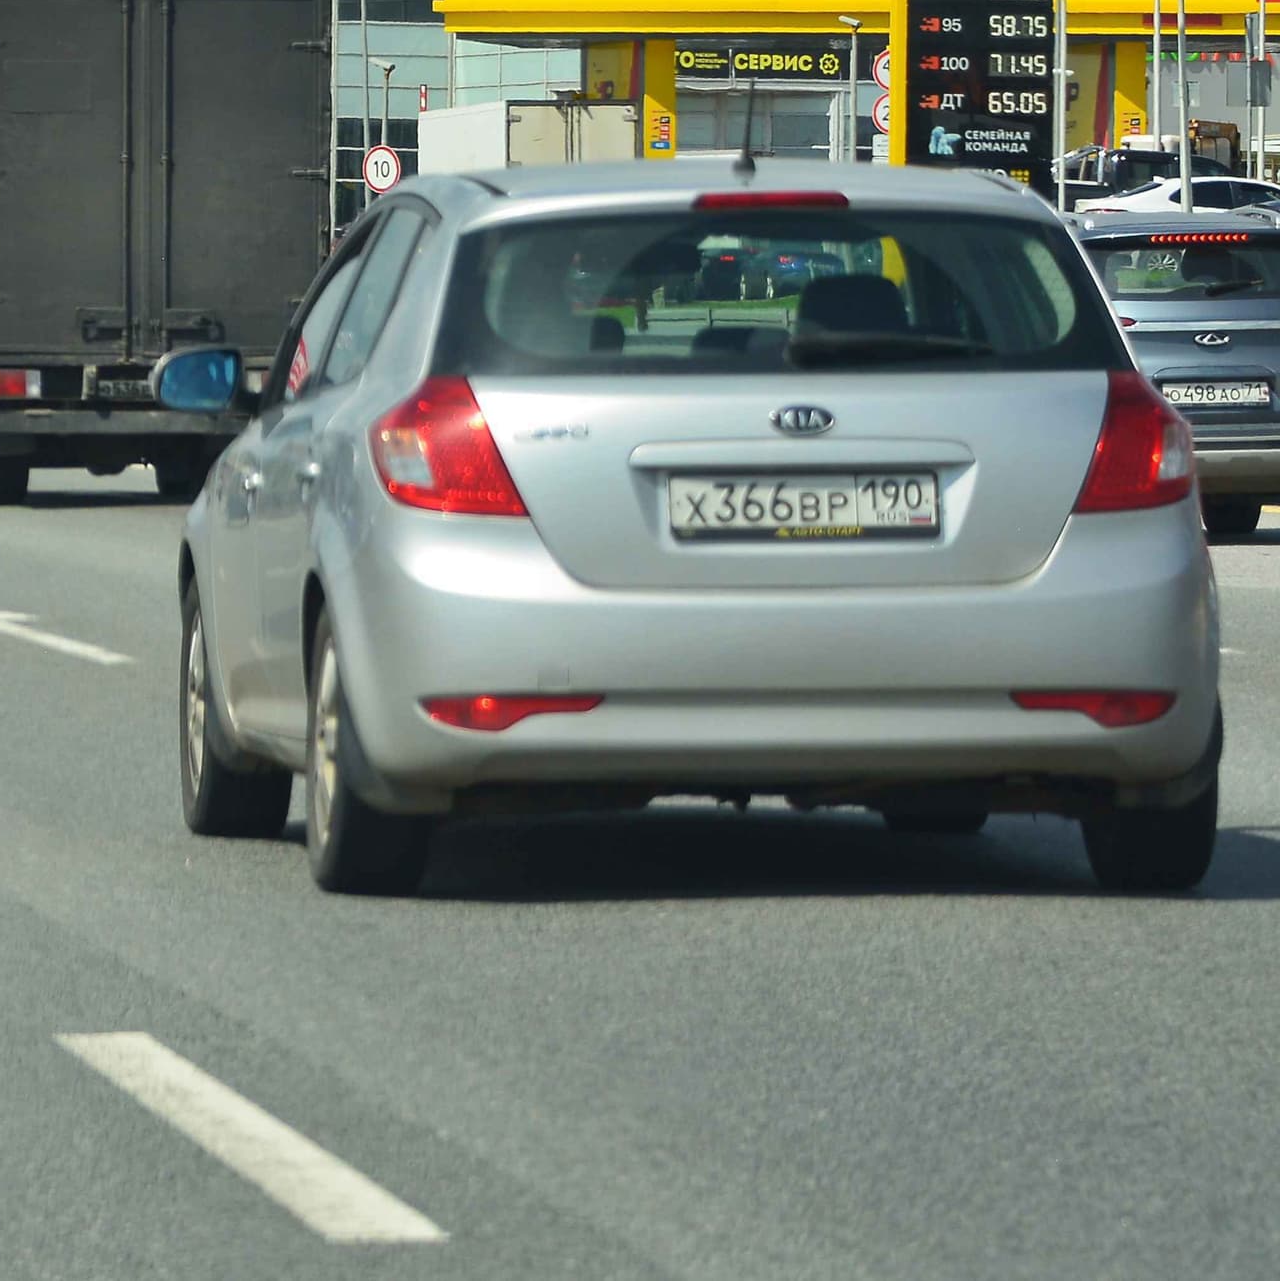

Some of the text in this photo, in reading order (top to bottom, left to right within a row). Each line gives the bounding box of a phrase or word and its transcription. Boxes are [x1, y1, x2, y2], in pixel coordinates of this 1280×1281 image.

[942, 15, 1047, 37] 95 58.75
[734, 53, 813, 71] СЕРВИС
[941, 54, 1047, 76] 100 71.45
[941, 92, 1047, 114] ДТ 65.05
[965, 129, 1031, 141] СЕМЕЙНАЯ
[965, 142, 1028, 153] КОМАНДА
[374, 161, 390, 178] 10
[1244, 383, 1262, 396] 71
[780, 409, 825, 430] KIA
[861, 479, 923, 510] 190
